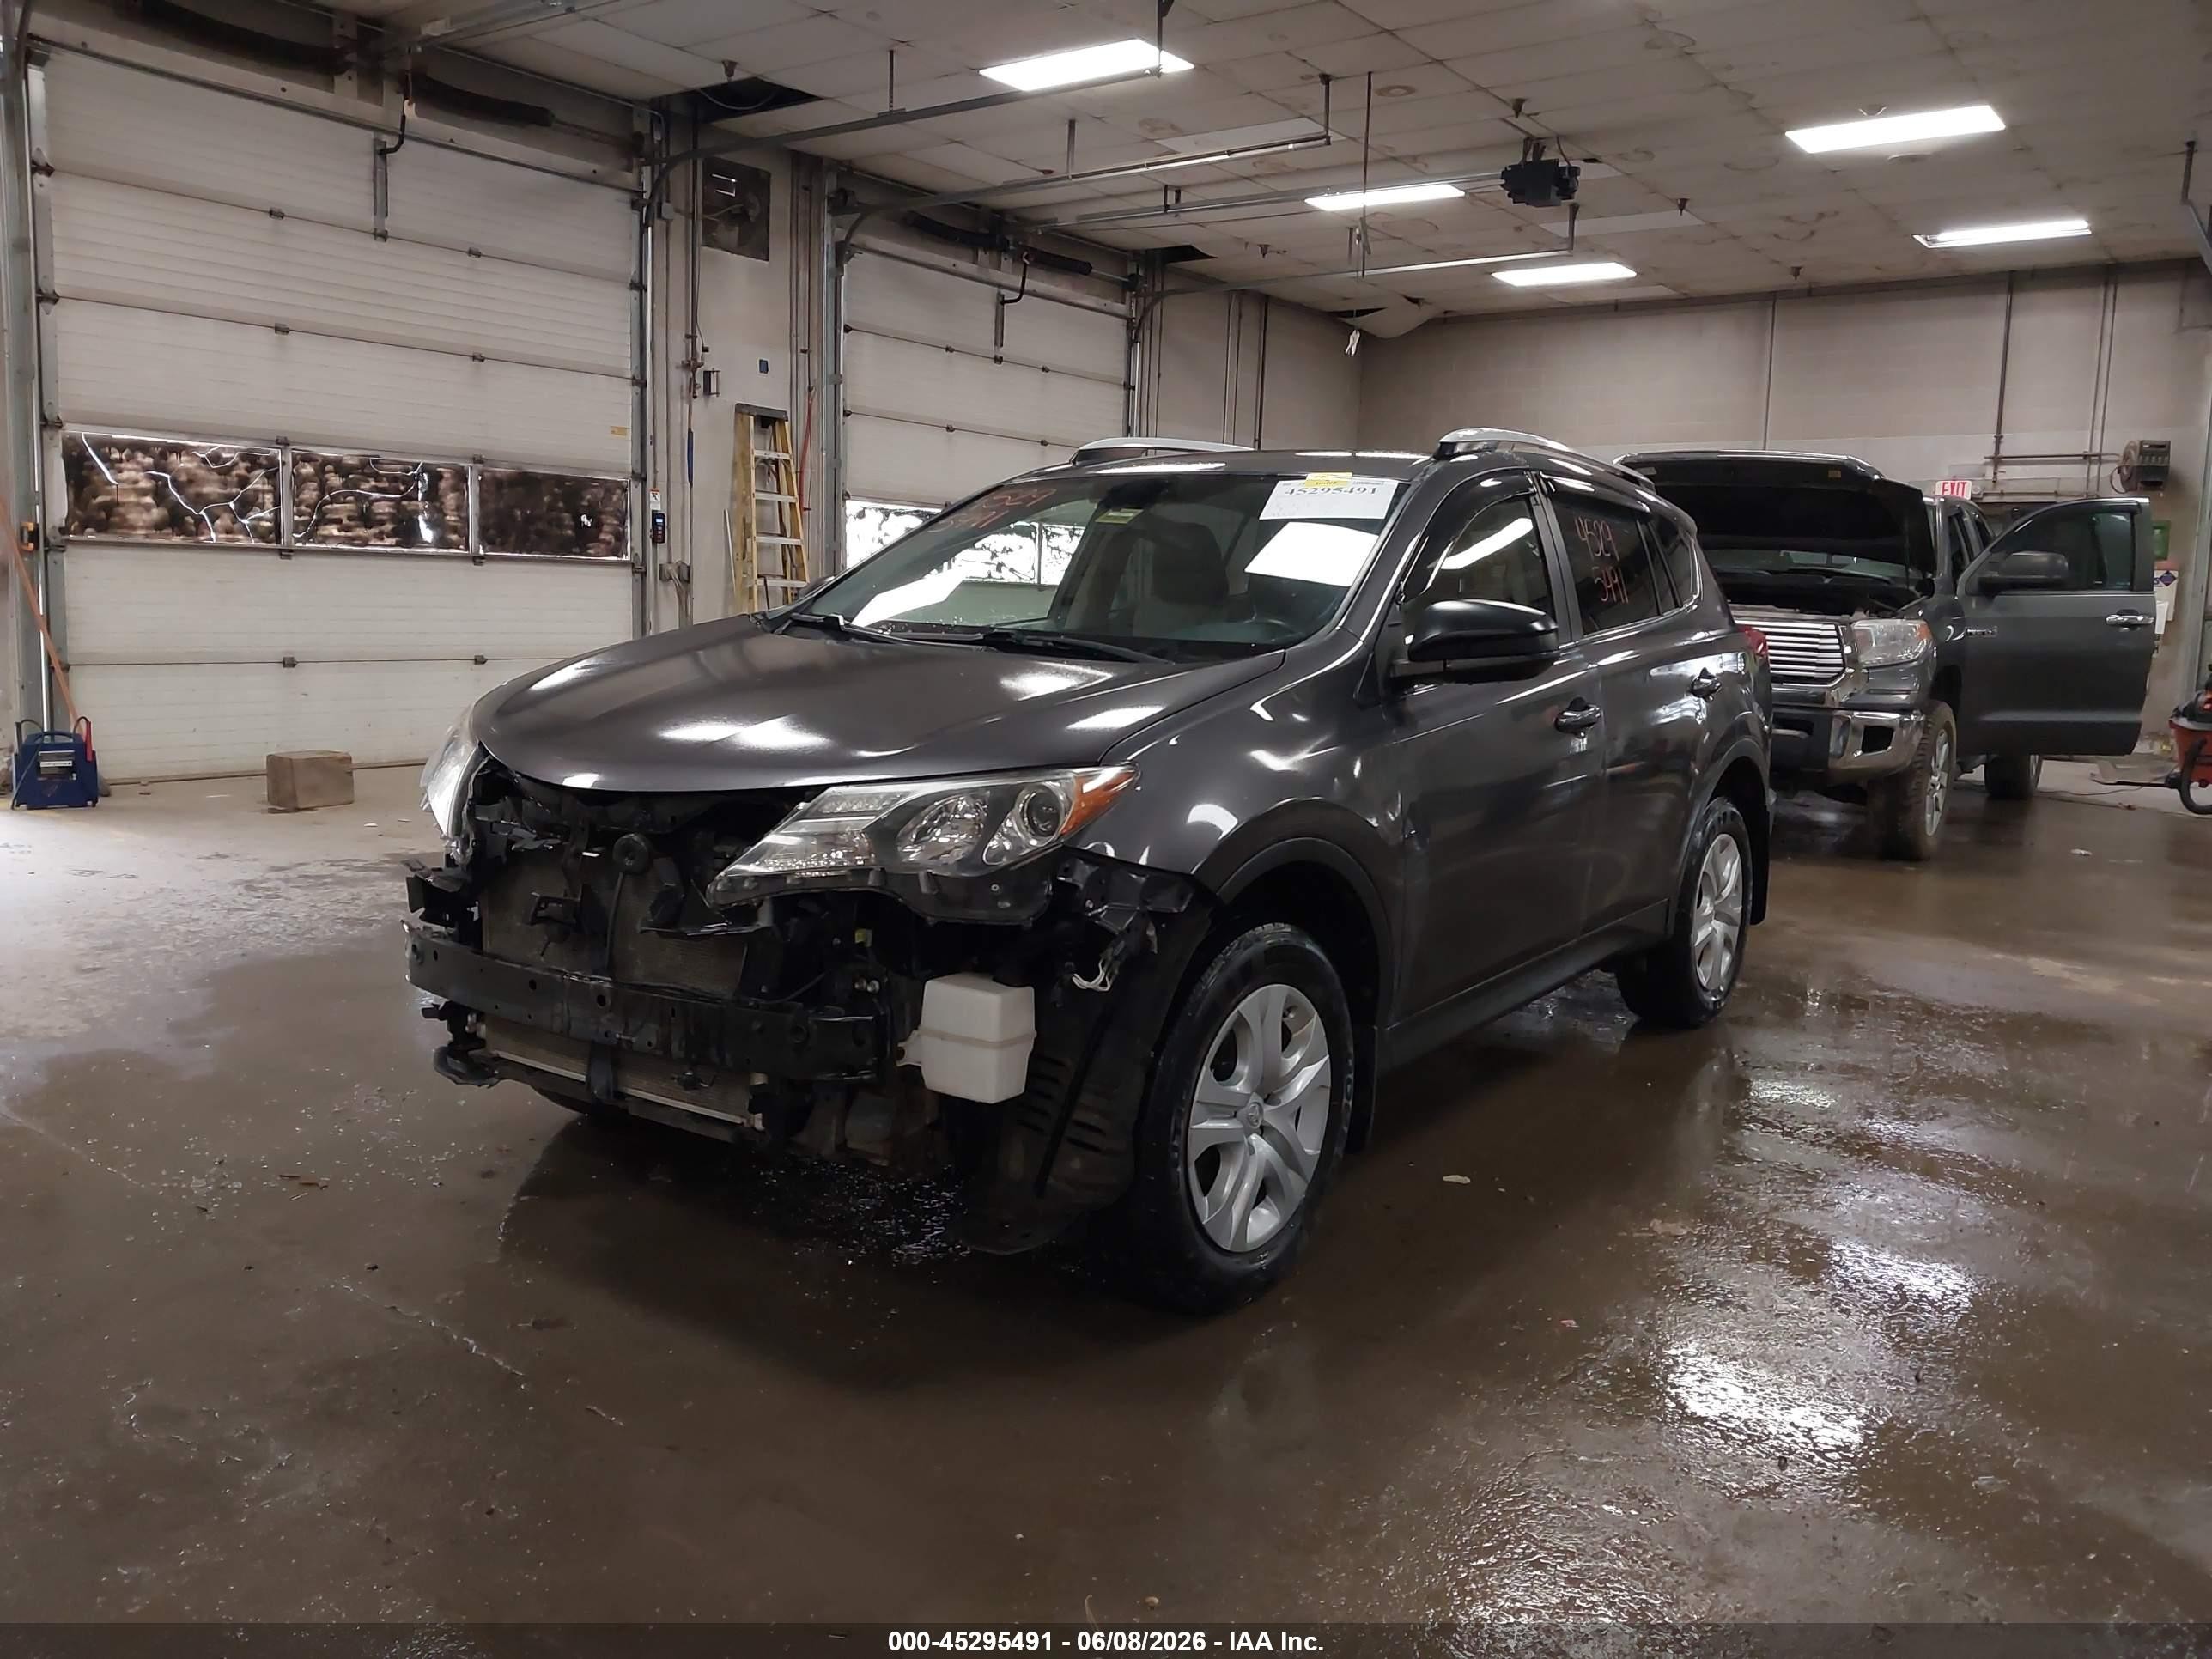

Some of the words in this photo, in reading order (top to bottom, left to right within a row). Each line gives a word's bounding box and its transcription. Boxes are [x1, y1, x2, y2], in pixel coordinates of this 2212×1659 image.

[1285, 487, 1379, 495] 45295491
[1942, 481, 1967, 497] EXIT
[1574, 516, 1620, 562] 4529
[1591, 565, 1629, 604] 5491
